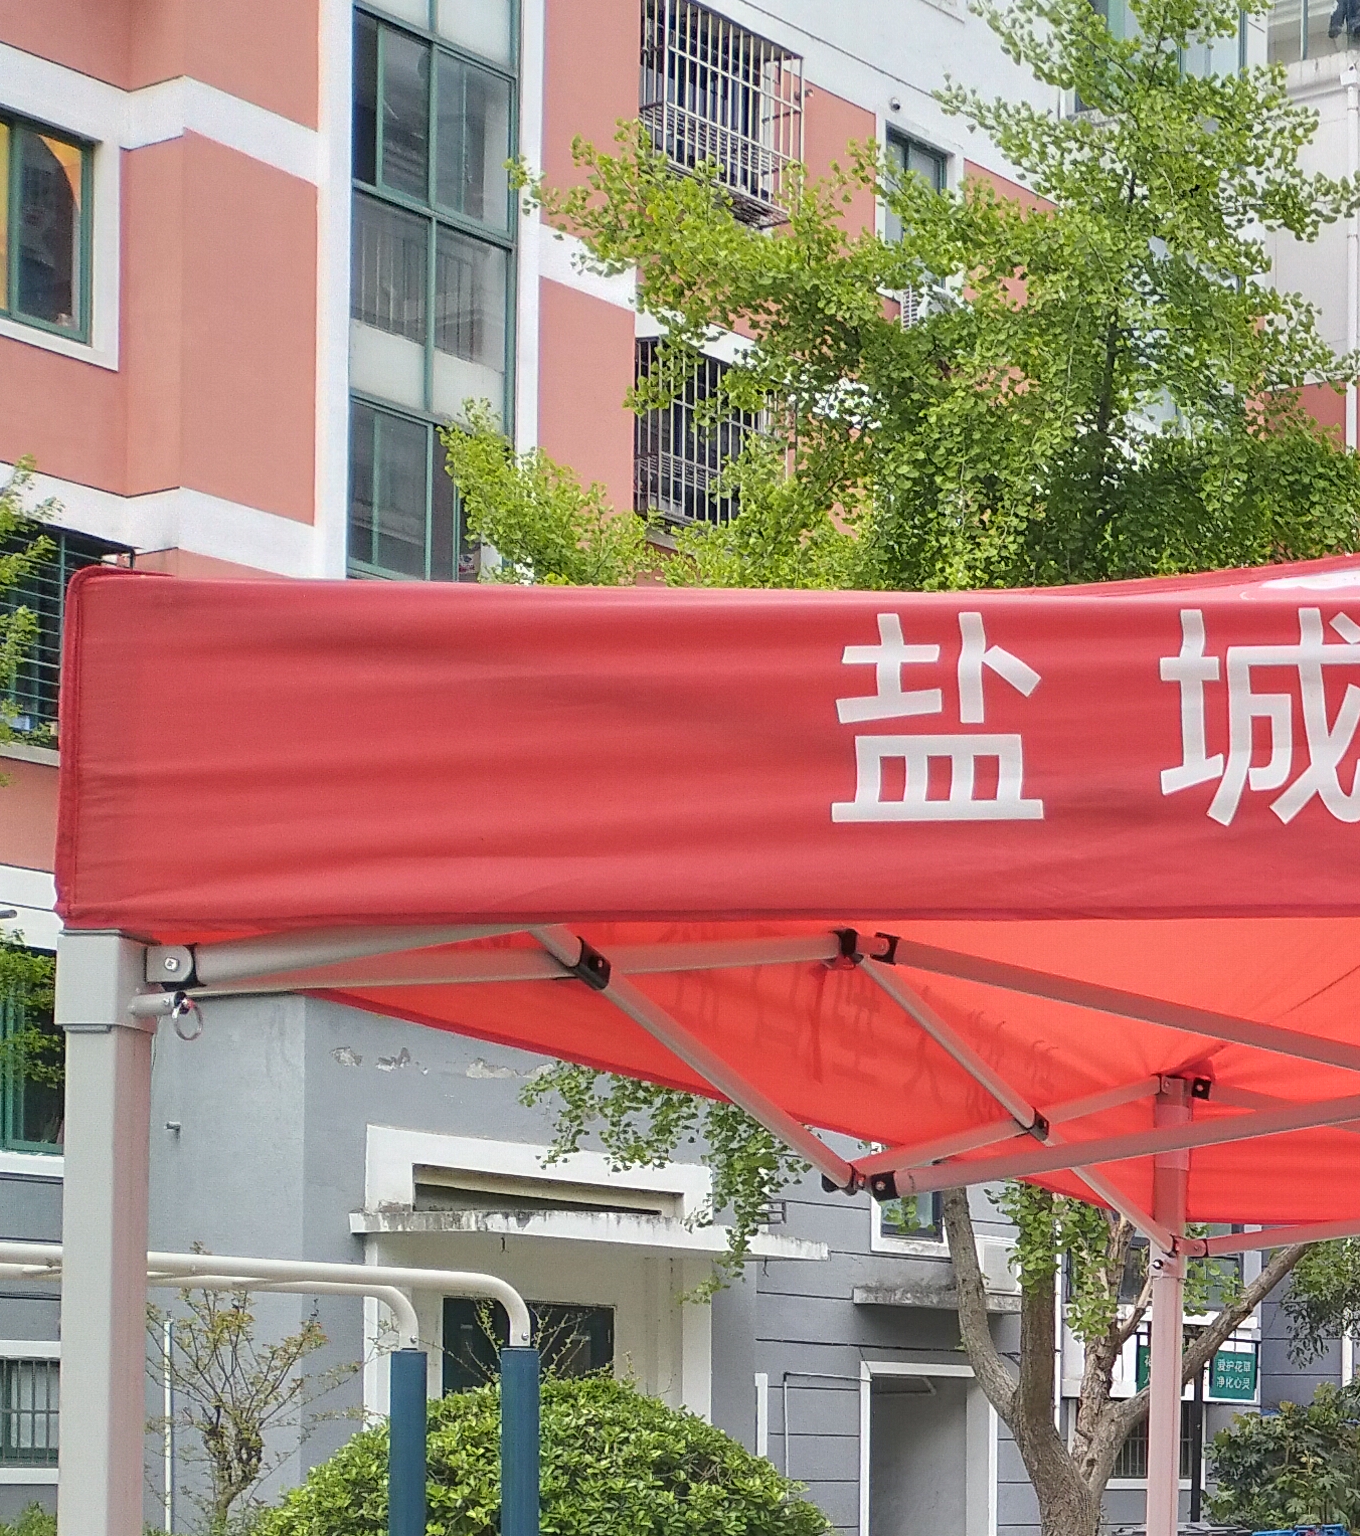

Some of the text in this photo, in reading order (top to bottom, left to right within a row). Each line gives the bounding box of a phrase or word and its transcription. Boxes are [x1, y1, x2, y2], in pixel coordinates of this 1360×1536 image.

[1216, 1358, 1251, 1372] 爱护花草
[1216, 1375, 1250, 1390] 净化心灵
